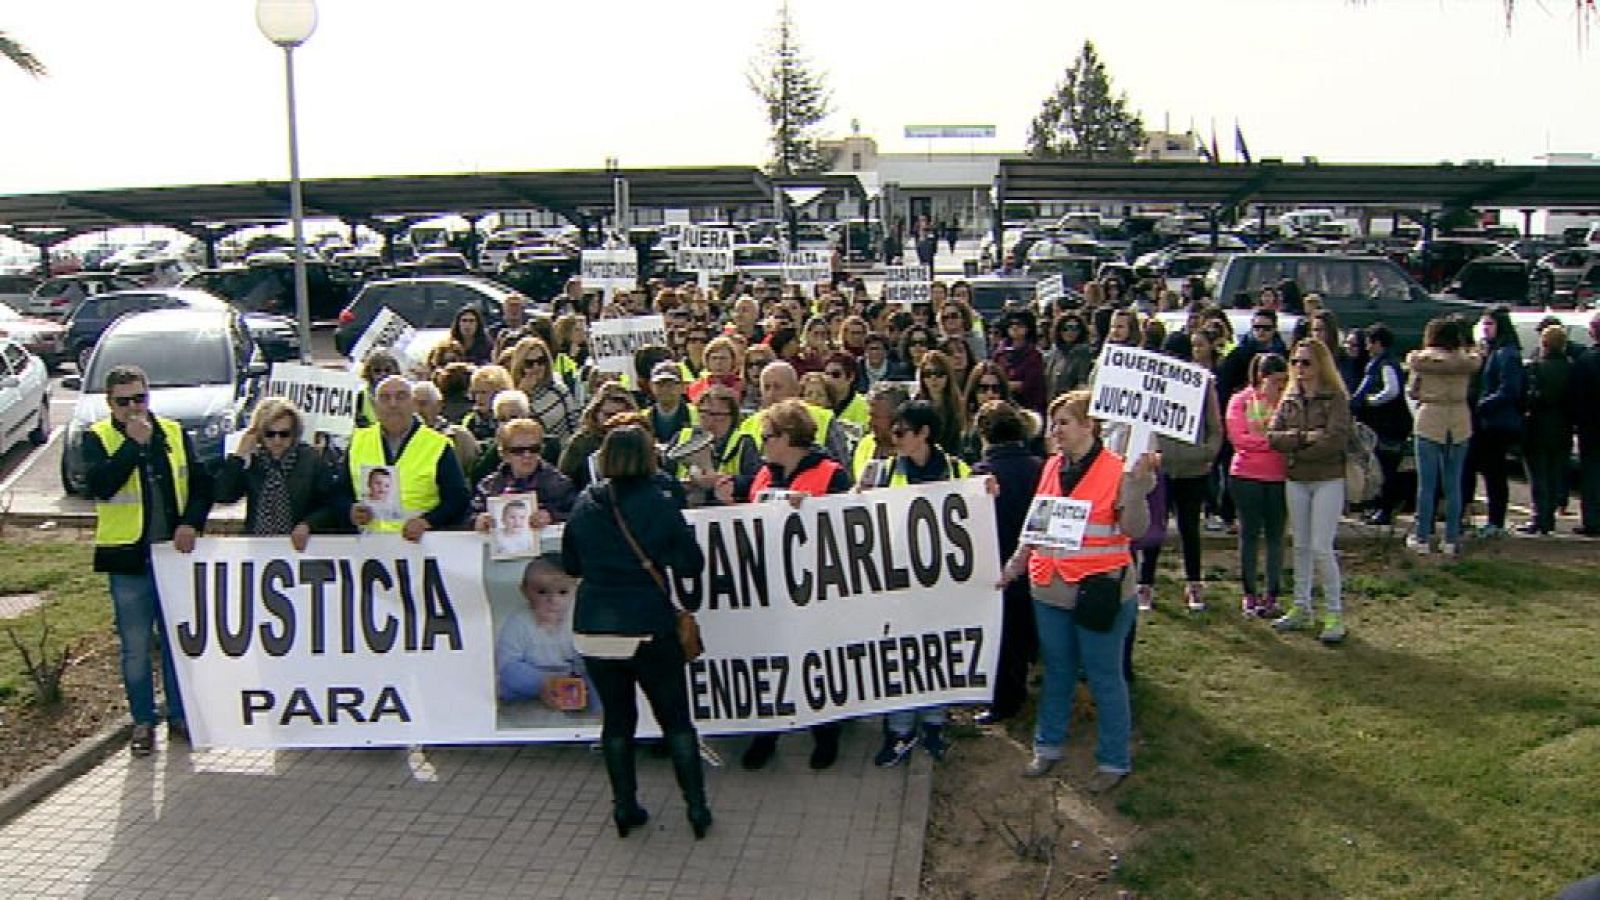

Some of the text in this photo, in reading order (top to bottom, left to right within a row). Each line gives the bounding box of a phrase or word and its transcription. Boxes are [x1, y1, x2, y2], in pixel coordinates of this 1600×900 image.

[1095, 386, 1142, 419] JUICIO
[1142, 375, 1167, 395] UN
[783, 493, 974, 607] CARLOS
[177, 559, 463, 657] JUSTICIA
[802, 622, 987, 711] GUTIÉRREZ
[241, 687, 411, 725] PARA
